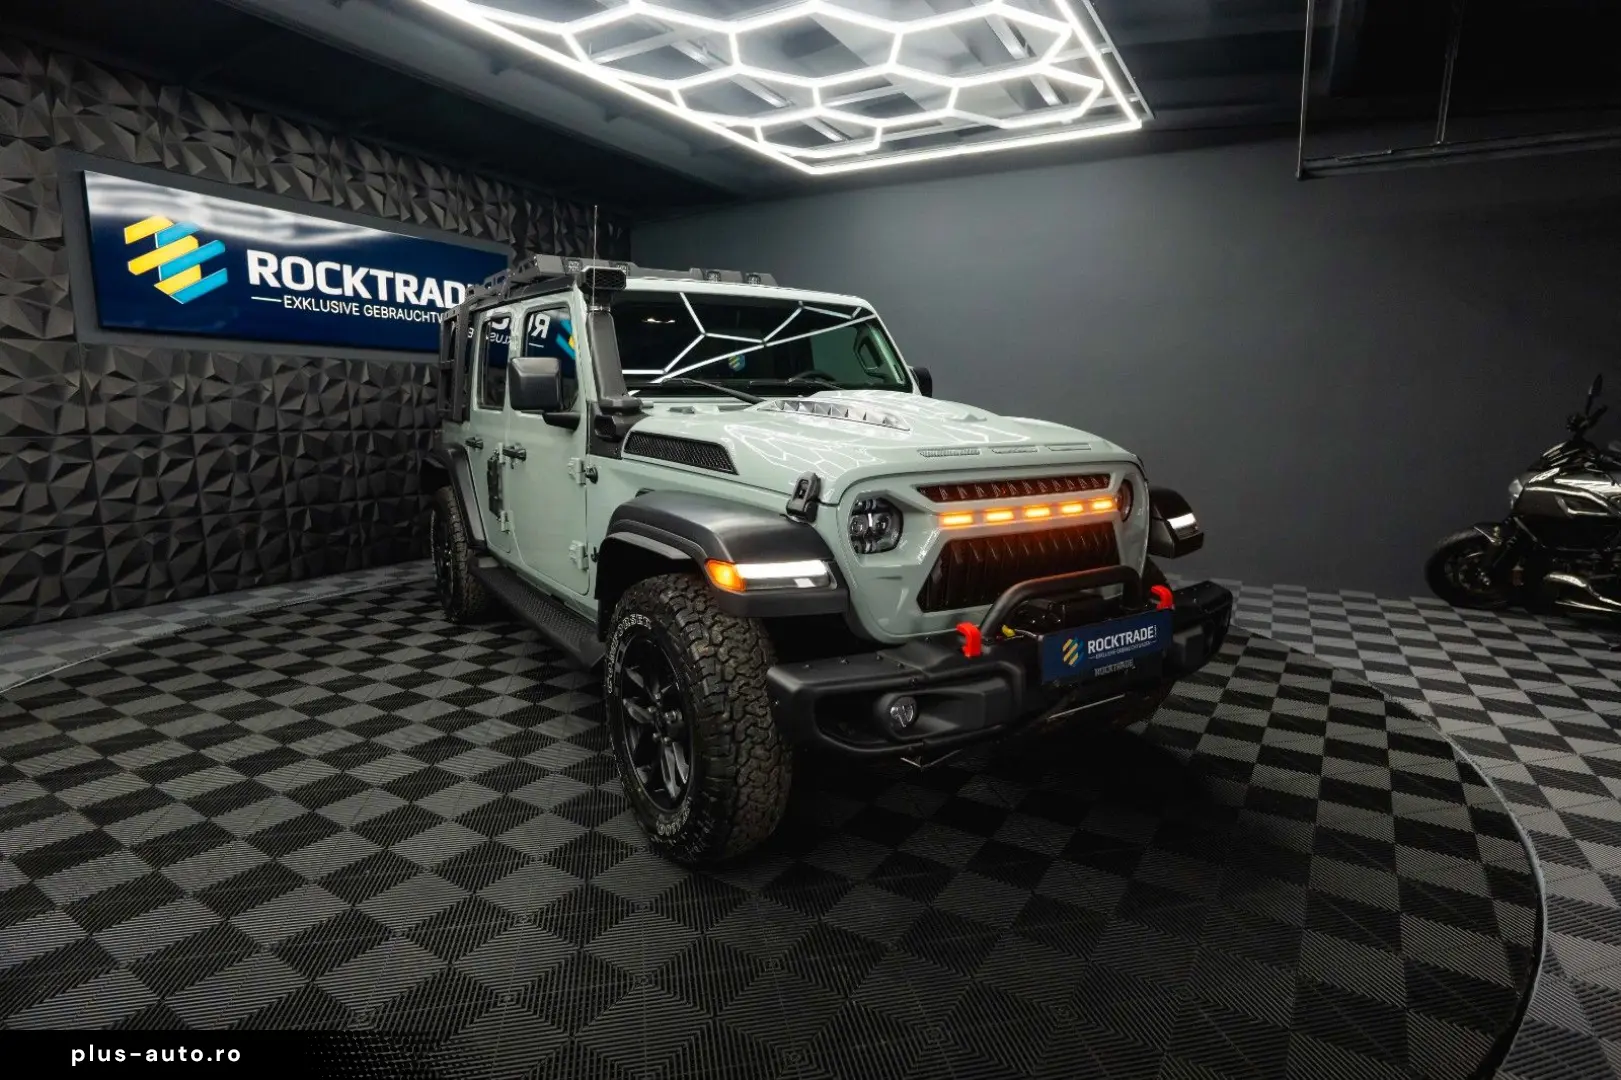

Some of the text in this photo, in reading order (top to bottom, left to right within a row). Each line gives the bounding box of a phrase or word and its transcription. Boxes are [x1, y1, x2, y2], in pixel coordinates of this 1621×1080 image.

[246, 249, 472, 309] ROCKTRAD
[284, 294, 360, 317] EXKLUSIVE
[1087, 625, 1154, 655] ROCKTRADE
